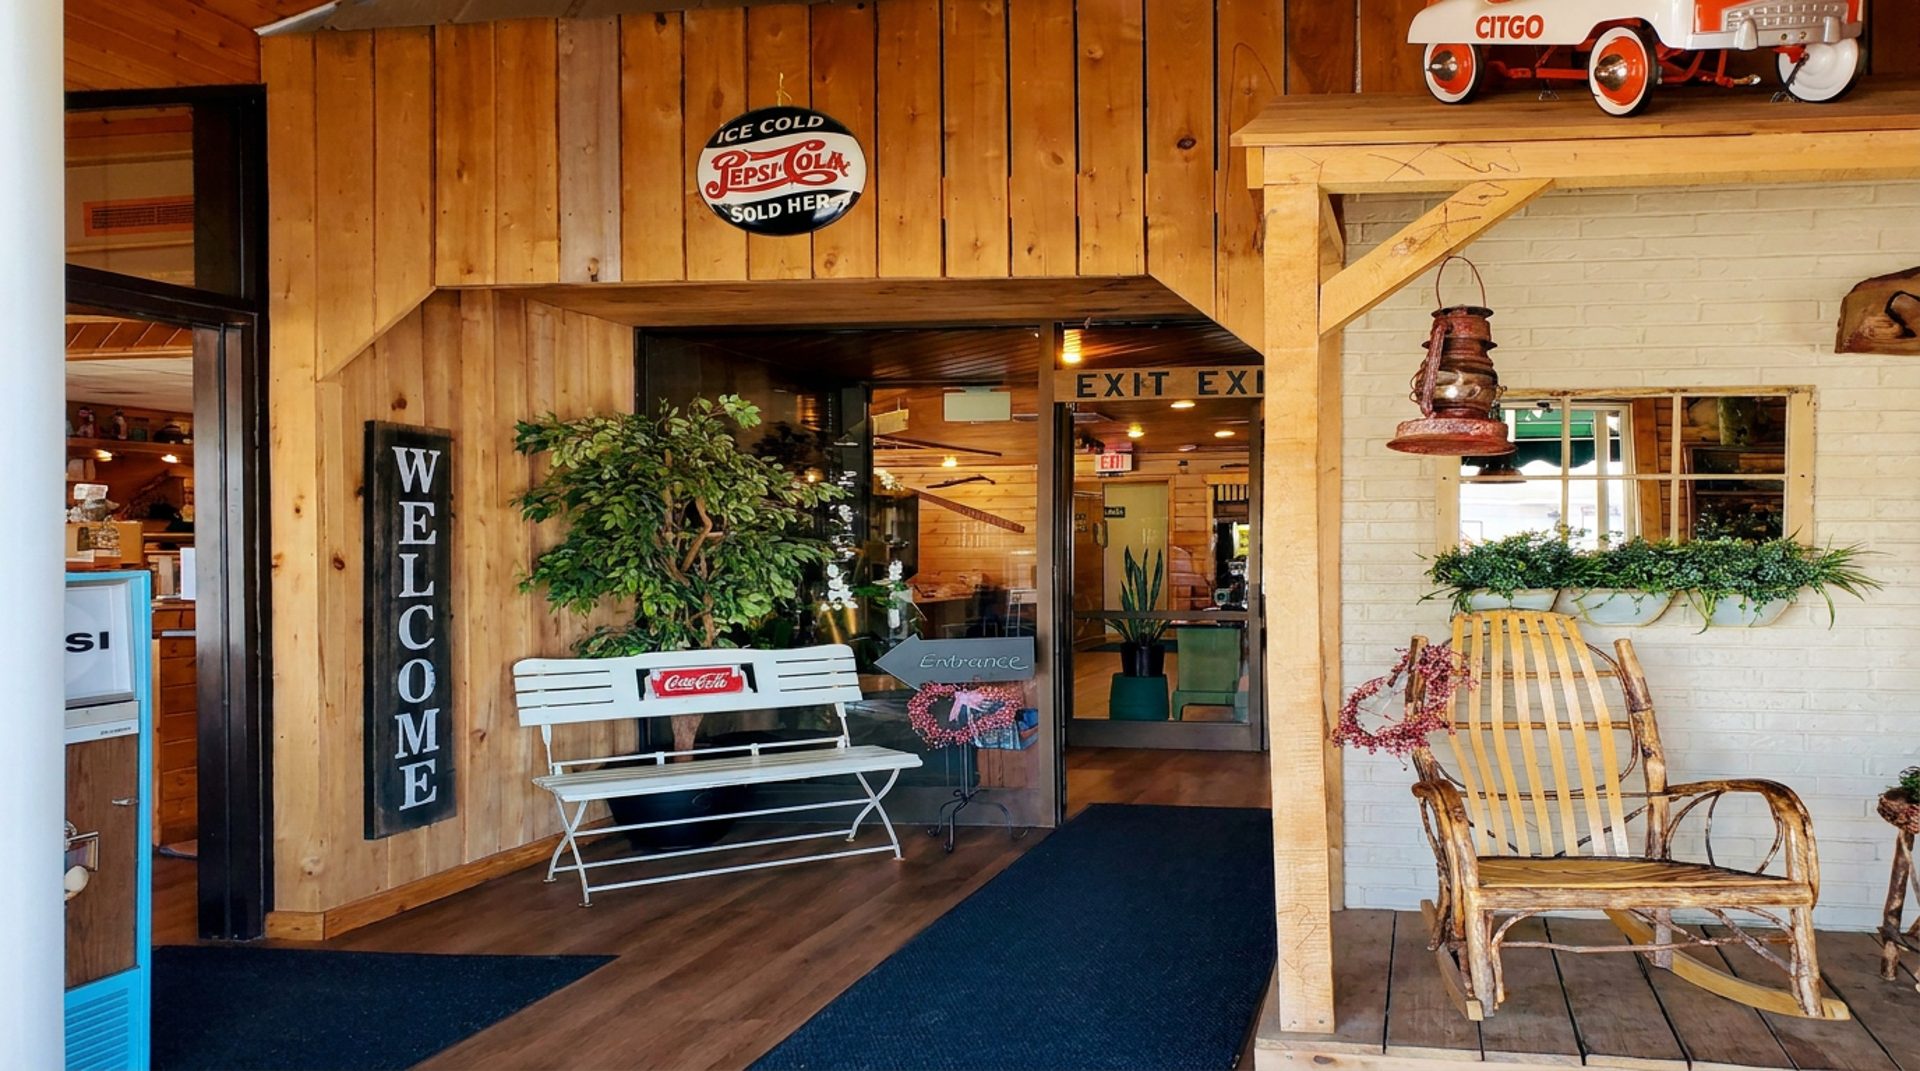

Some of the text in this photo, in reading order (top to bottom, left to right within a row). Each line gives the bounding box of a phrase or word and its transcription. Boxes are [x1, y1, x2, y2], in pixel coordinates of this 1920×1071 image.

[1475, 14, 1544, 39] CITGO
[716, 115, 825, 144] ICE COLD
[730, 203, 782, 223] SOLD
[1076, 371, 1170, 398] EXIT
[391, 446, 442, 811] WELCOME
[920, 653, 1030, 671] Entrance
